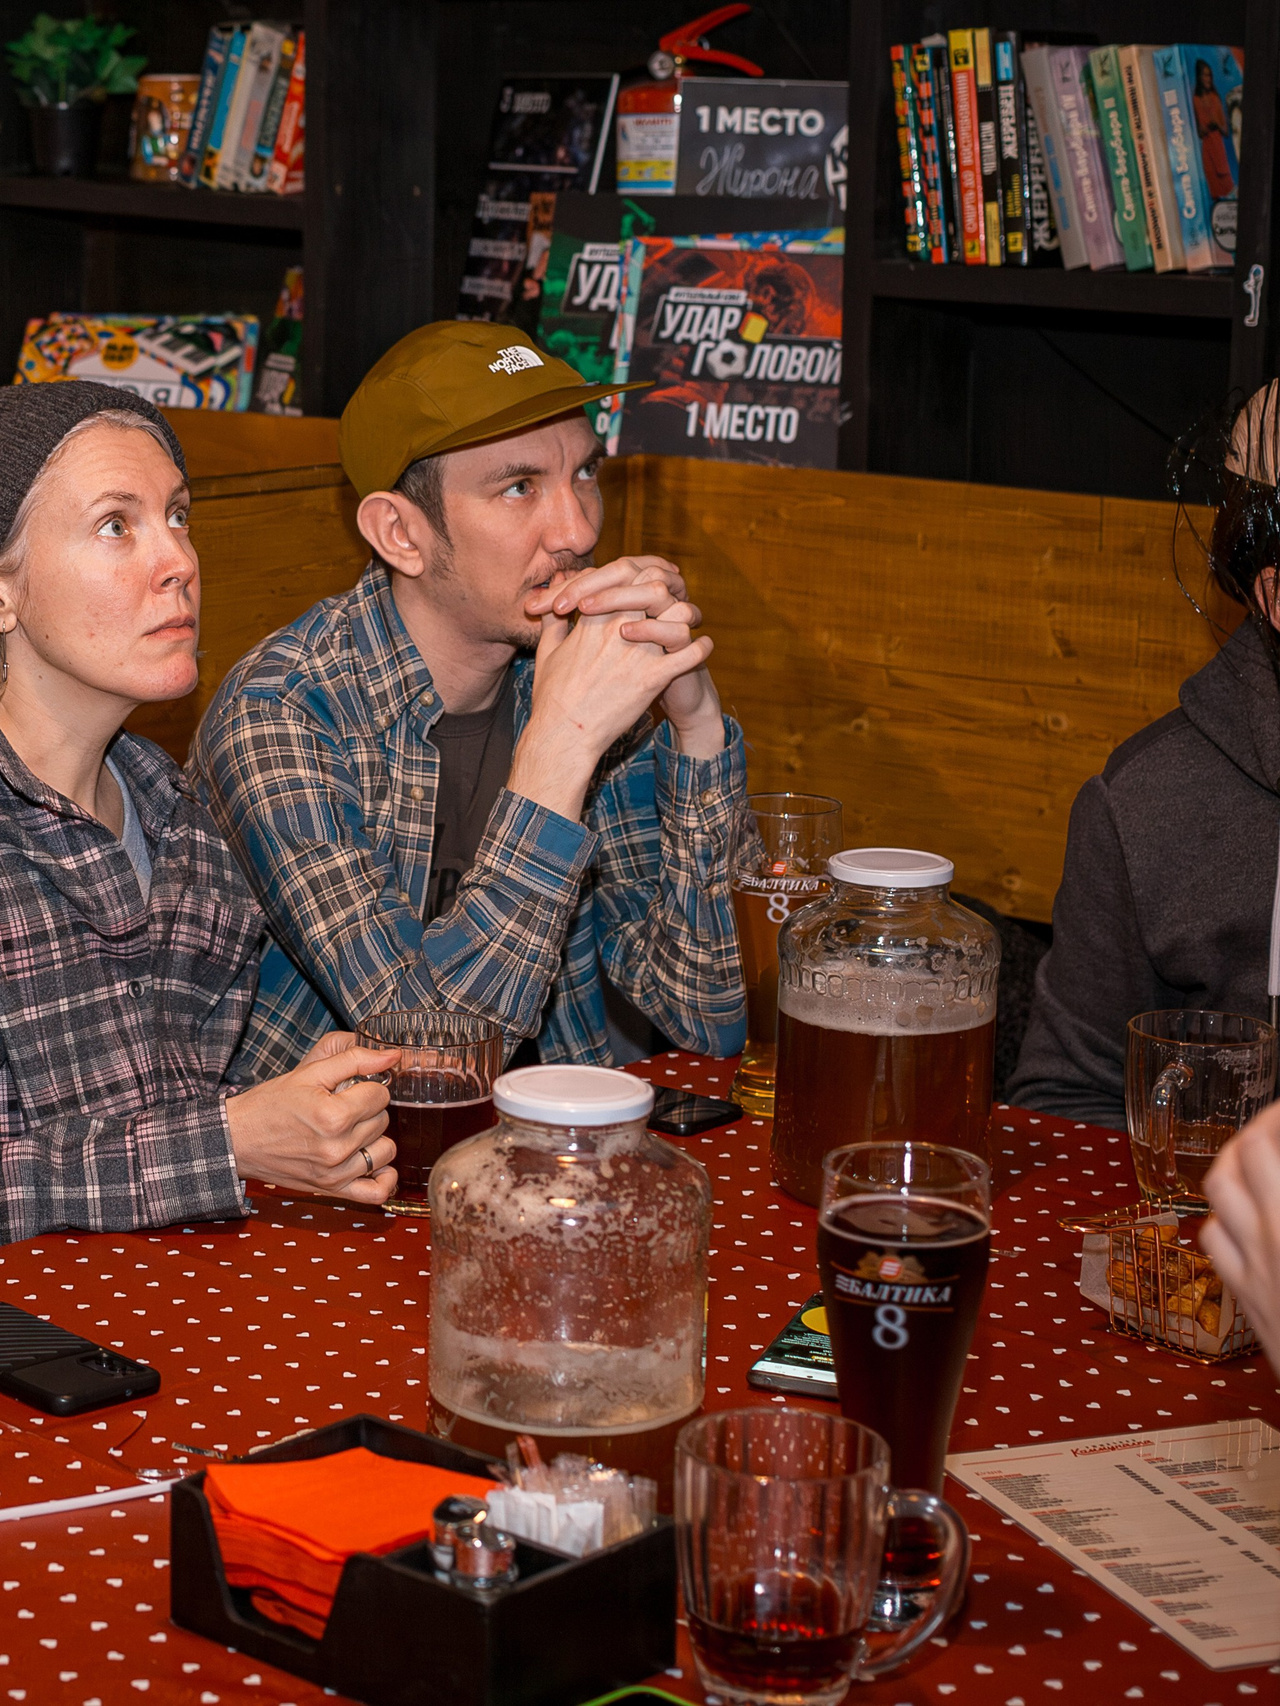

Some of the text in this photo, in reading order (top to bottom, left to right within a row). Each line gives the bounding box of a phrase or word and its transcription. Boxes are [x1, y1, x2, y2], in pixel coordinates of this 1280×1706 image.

[696, 105, 825, 137] 1 МЕСТО
[998, 85, 1019, 160] ЖЕРЕБЕЦ
[695, 142, 820, 200] Жирона
[659, 303, 742, 345] УДАР
[488, 353, 523, 373] NORTH
[497, 347, 518, 358] THE
[505, 358, 530, 375] FACE
[686, 401, 799, 444] 1 МЕСТО
[750, 877, 820, 891] БАЛТИКА
[766, 893, 790, 923] 8
[847, 1277, 952, 1303] БАЛТИКА
[872, 1304, 909, 1350] 8
